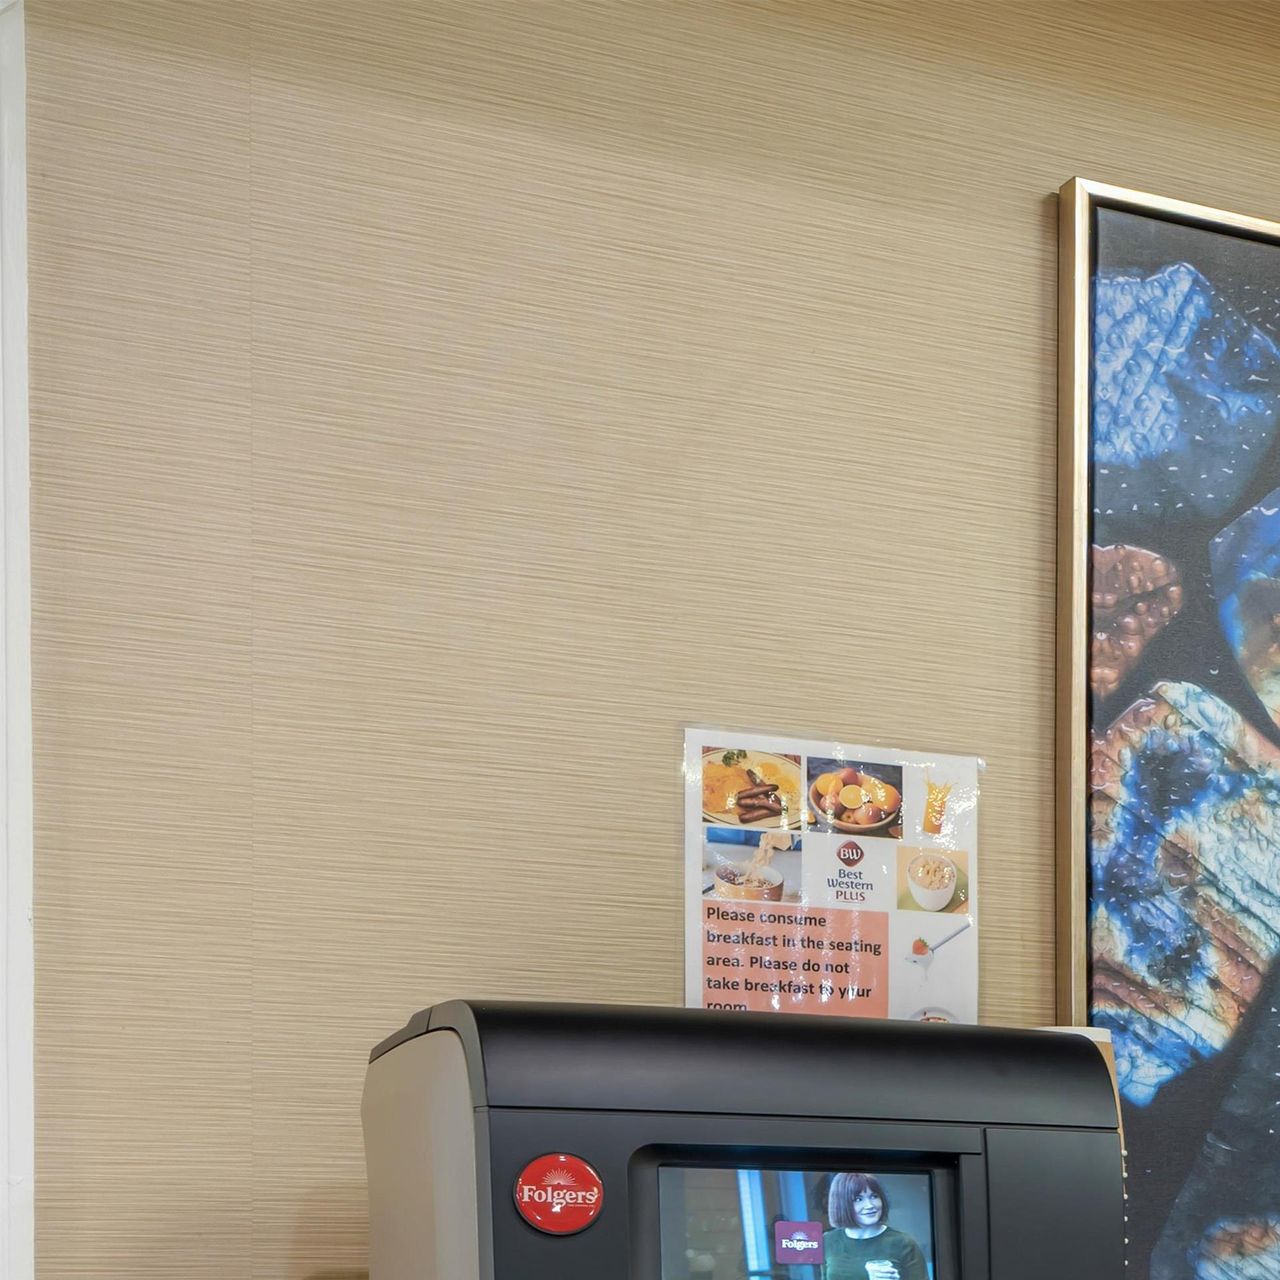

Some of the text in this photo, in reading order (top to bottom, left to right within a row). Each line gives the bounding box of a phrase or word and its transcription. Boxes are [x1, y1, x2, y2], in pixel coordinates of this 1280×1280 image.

[840, 848, 861, 860] BW
[838, 868, 863, 880] Best
[827, 878, 873, 891] Western
[836, 890, 866, 901] PLUS
[707, 906, 826, 927] Please consume
[707, 930, 882, 956] breakfast in the seating
[707, 956, 850, 974] area. Please do not
[706, 977, 740, 990] take
[744, 978, 815, 995] breakfast
[521, 1185, 597, 1209] Folgers
[781, 1239, 819, 1251] Folgers
